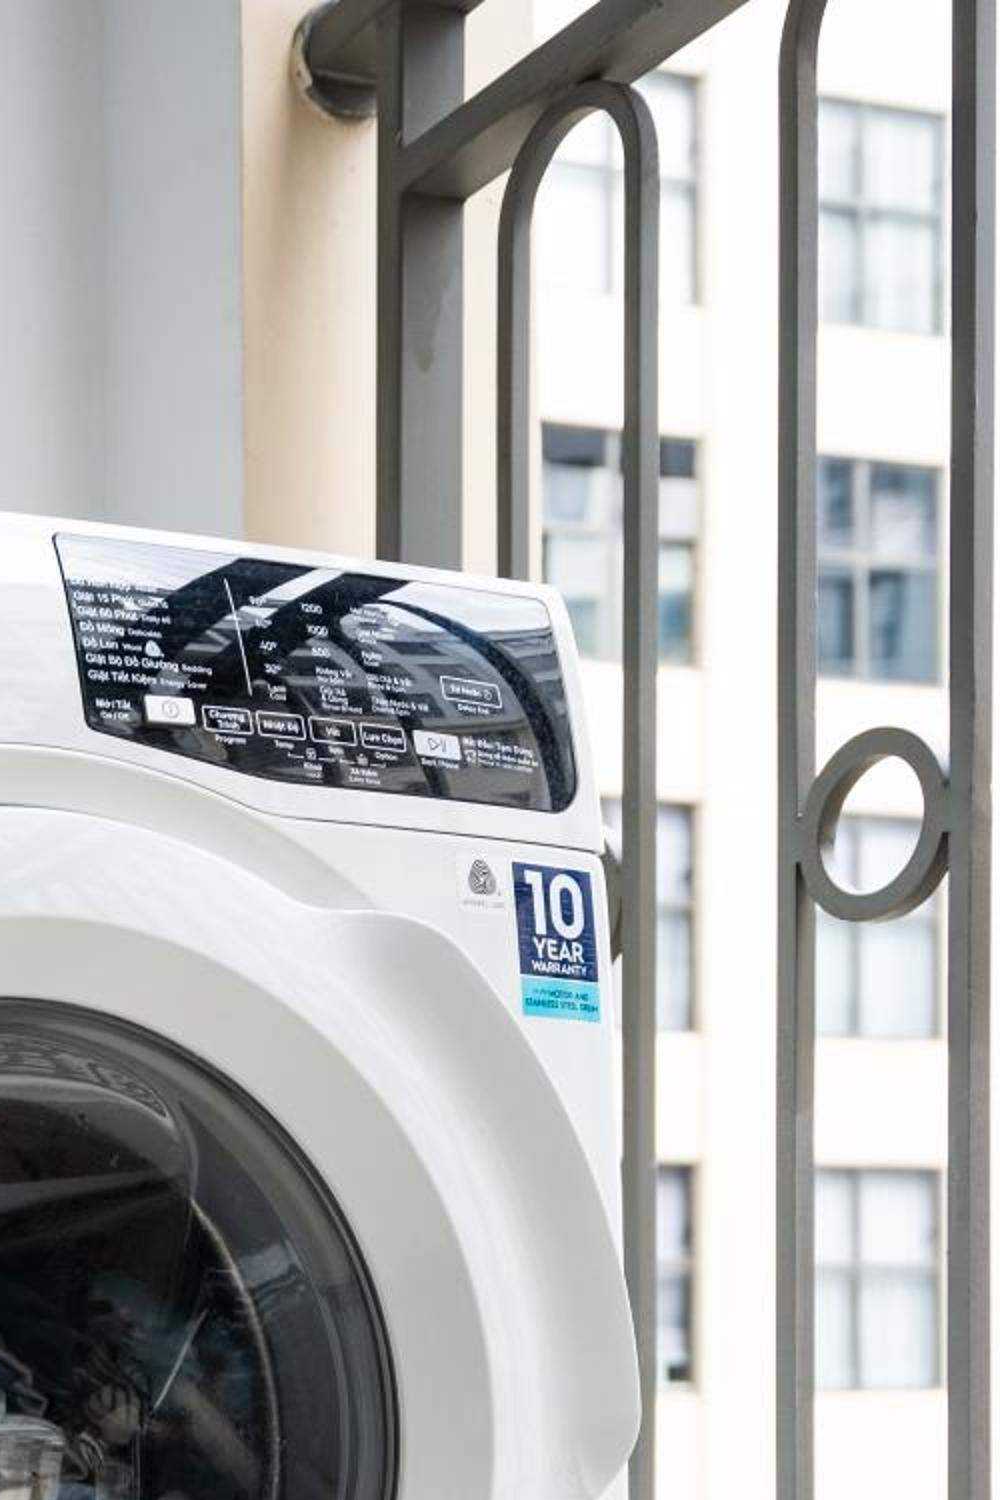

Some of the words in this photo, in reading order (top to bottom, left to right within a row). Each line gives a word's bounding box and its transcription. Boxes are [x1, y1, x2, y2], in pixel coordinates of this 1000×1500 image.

[301, 603, 323, 614] 1200
[524, 869, 584, 941] 10
[532, 936, 584, 963] YEAR
[531, 959, 588, 977] WARRANTY
